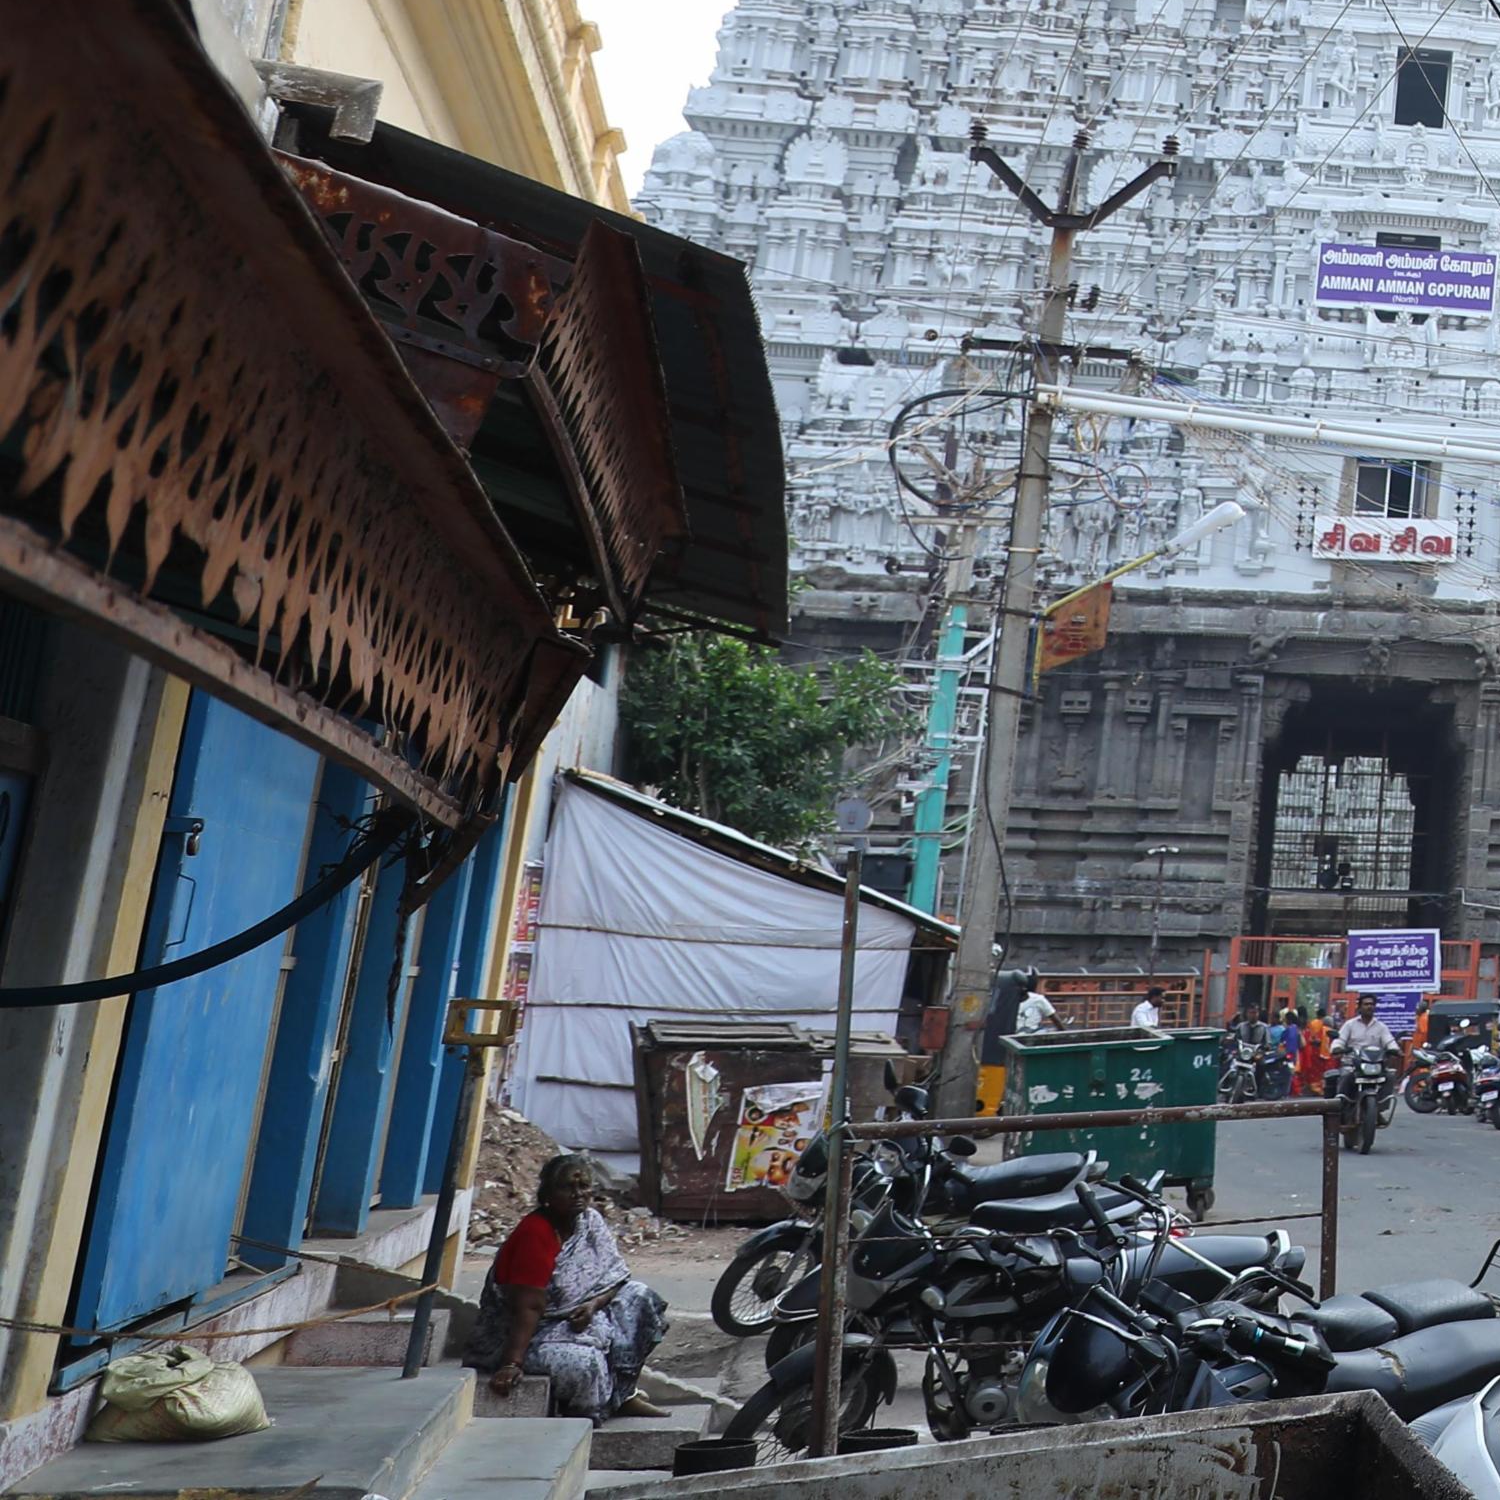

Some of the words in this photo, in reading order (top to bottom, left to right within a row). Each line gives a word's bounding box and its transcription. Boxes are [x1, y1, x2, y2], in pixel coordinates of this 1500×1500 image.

[1385, 252, 1438, 270] அம்மன்
[1320, 275, 1374, 292] AMMANI
[1376, 280, 1425, 296] AMMAN
[1427, 282, 1491, 301] GOPURAM
[1352, 970, 1371, 979] WAY
[1372, 970, 1384, 978] TO
[1130, 1067, 1153, 1082] 24
